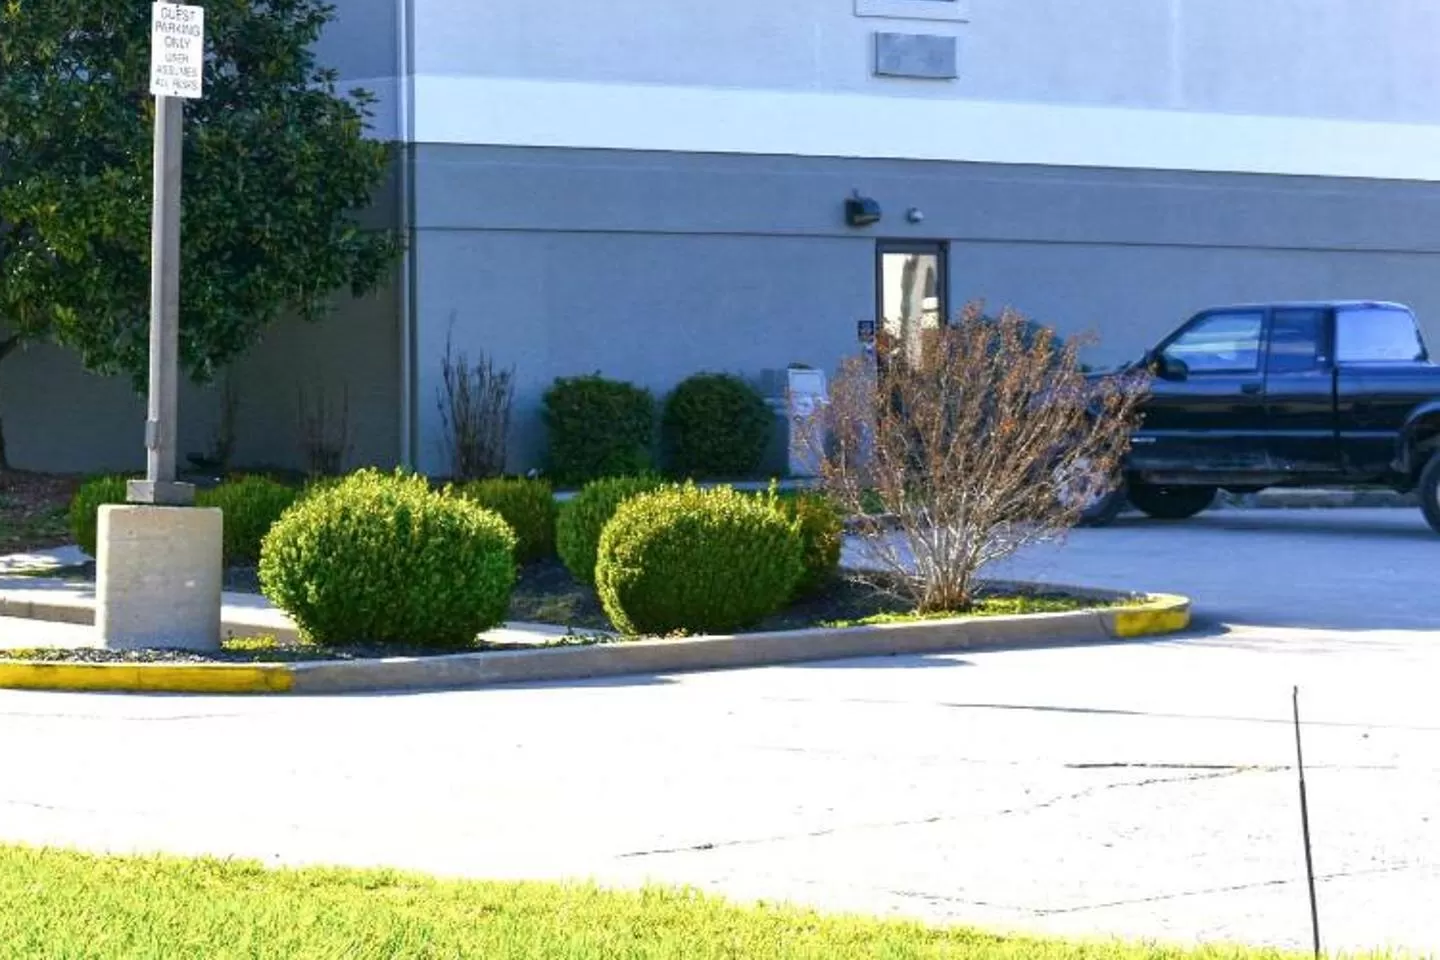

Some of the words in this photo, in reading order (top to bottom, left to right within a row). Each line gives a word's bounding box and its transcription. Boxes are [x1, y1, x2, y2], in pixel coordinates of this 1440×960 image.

[160, 7, 196, 22] GUEST
[155, 20, 201, 37] PARKING
[164, 35, 191, 49] ONLY
